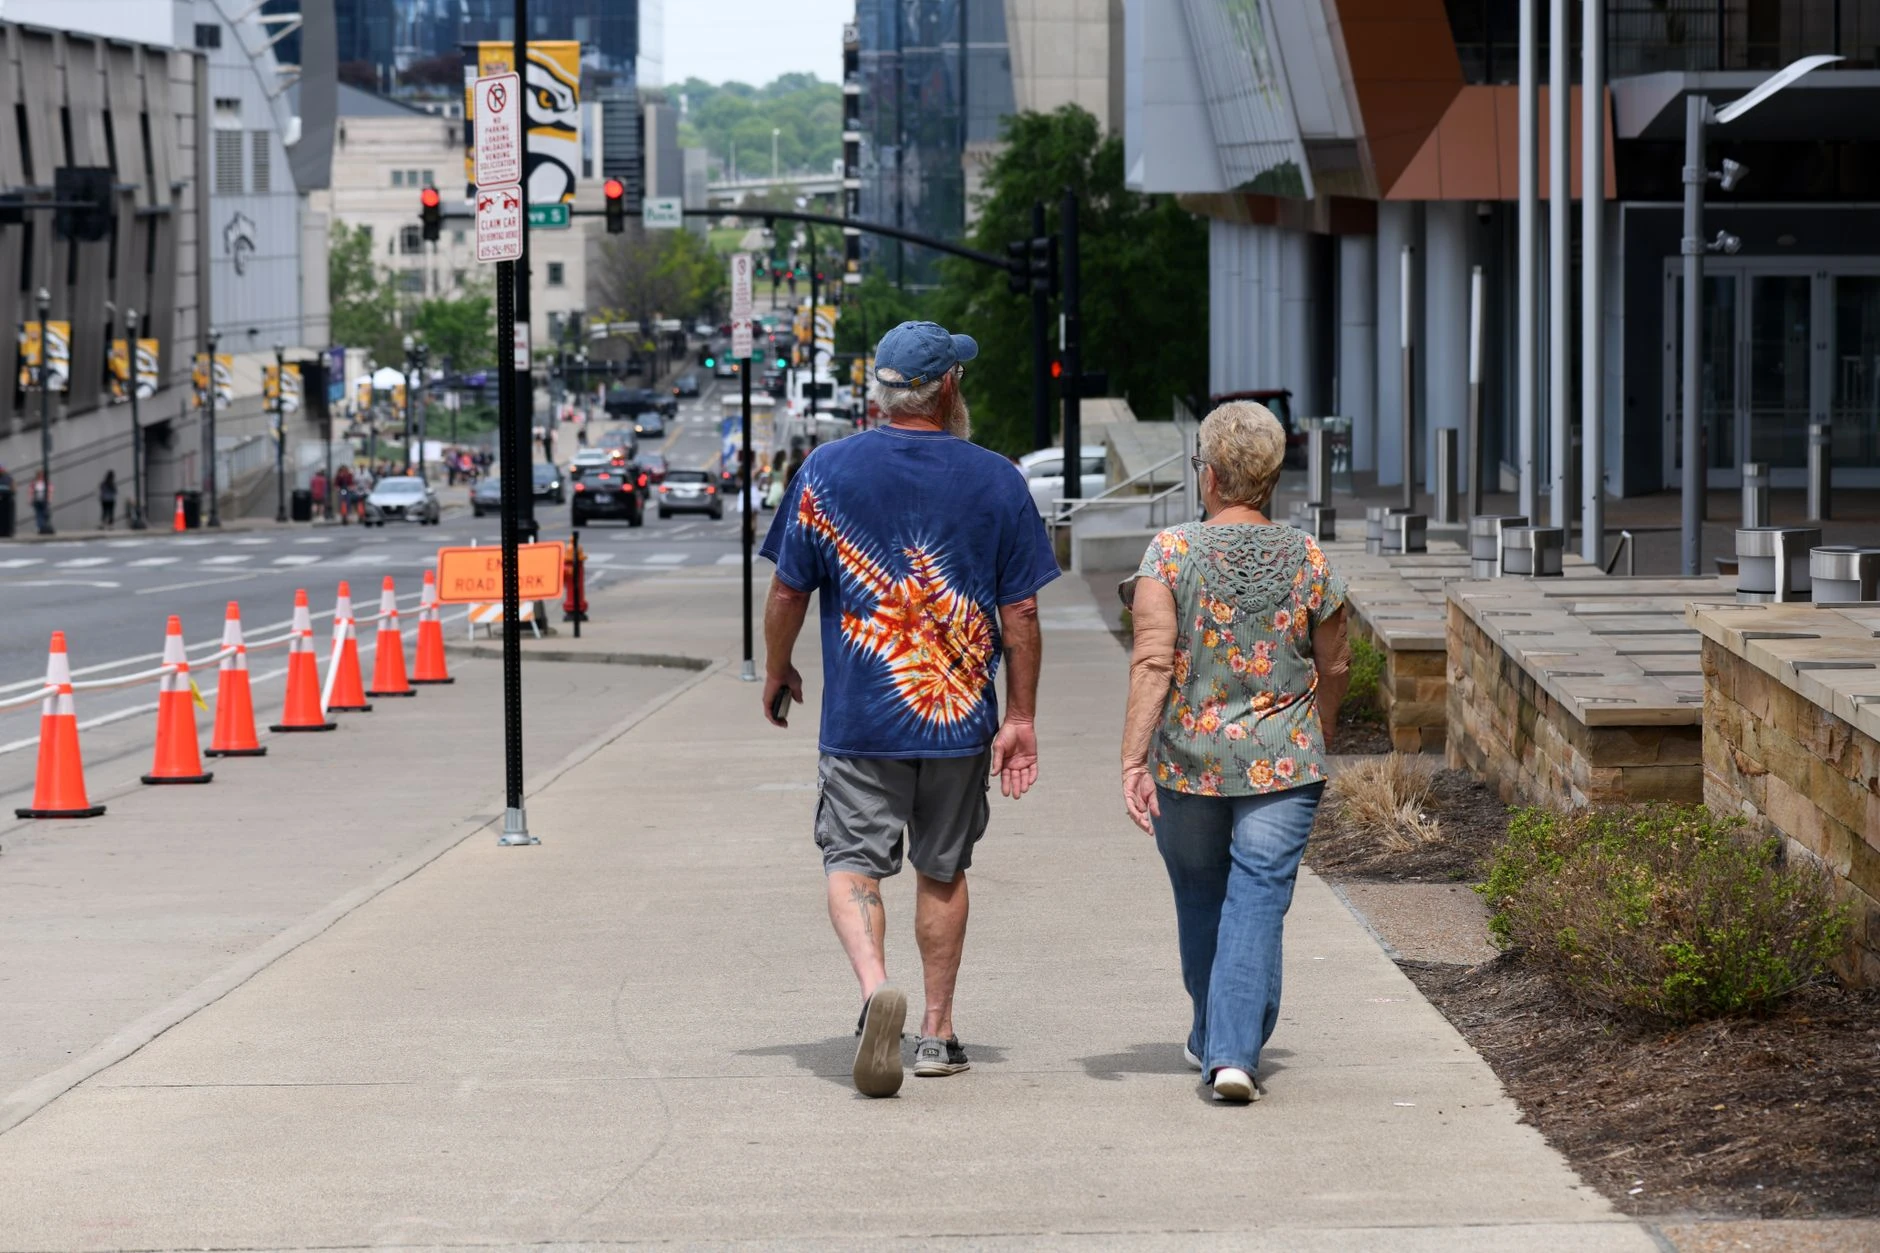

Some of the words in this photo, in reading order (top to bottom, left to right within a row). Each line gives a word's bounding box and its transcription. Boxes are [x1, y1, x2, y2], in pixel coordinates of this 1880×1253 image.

[485, 124, 510, 133] PARKING
[485, 134, 510, 143] LOADING
[482, 142, 514, 152] UNLOADING
[485, 151, 510, 160] VENDING
[480, 159, 516, 170] SOLICITATION
[528, 210, 546, 223] ve
[481, 219, 501, 231] CLAIM
[503, 216, 516, 228] CAR
[487, 558, 503, 571] EN
[455, 578, 495, 592] ROAD
[518, 575, 544, 588] ORK
